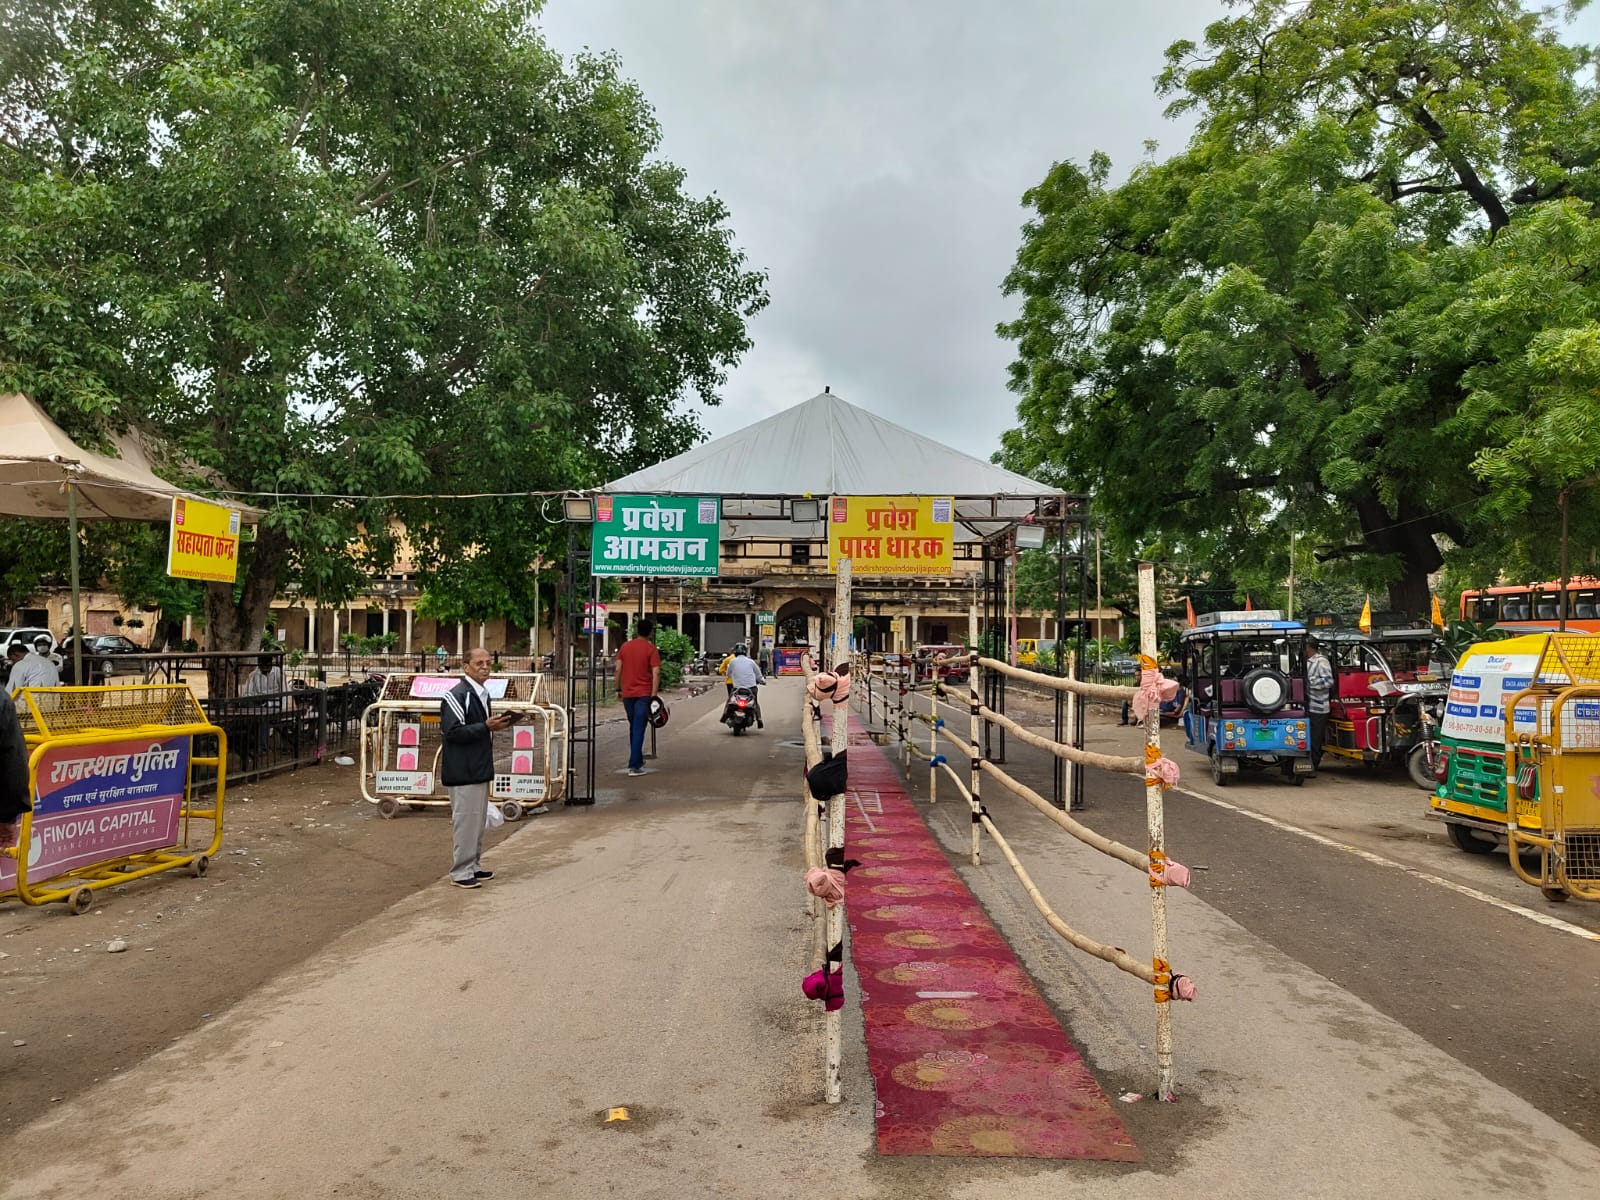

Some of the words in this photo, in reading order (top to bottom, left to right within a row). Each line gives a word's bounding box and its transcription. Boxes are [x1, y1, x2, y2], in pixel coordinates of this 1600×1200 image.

[622, 500, 686, 532] प्रवेश
[865, 501, 919, 532] प्रवेश
[177, 530, 215, 557] सहायता
[216, 530, 236, 560] केन्द्र
[603, 536, 709, 560] आमजन
[838, 537, 882, 559] पास
[886, 537, 944, 559] धारक
[51, 755, 131, 783] राजस्थान
[132, 743, 179, 782] पुलिस
[63, 793, 83, 809] सुगम
[85, 789, 99, 803] एवं
[99, 785, 126, 803] सुरक्षित
[127, 783, 159, 796] यातायात
[43, 819, 95, 845] FINOVA
[100, 808, 157, 832] CAPITAL
